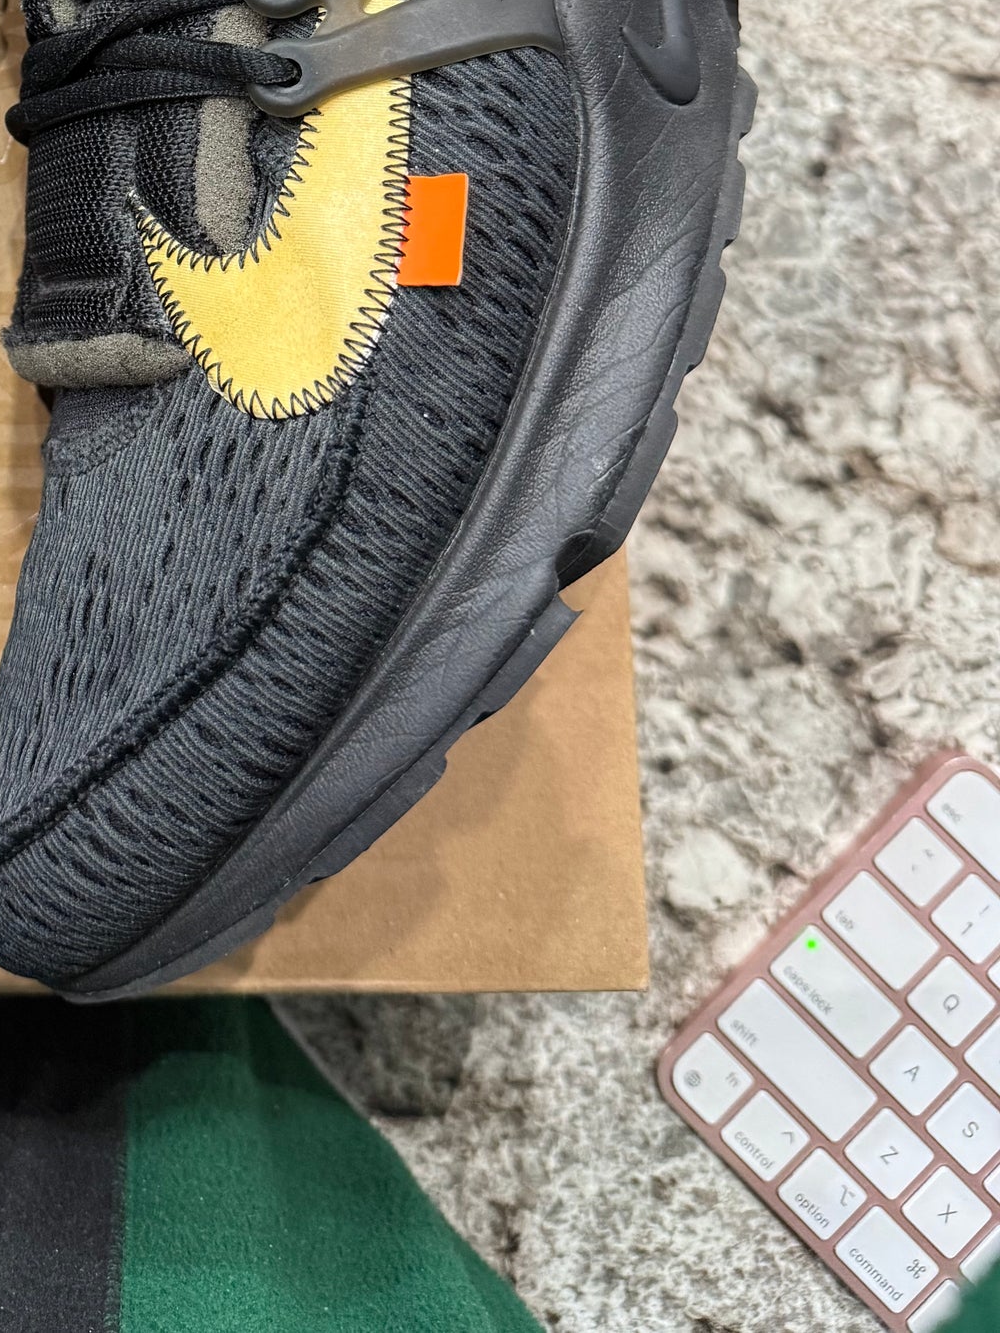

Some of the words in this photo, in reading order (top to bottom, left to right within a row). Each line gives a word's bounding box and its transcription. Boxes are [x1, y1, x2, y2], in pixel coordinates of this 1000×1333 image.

[961, 921, 974, 936] 1
[807, 988, 834, 1016] lock
[943, 994, 960, 1014] Q
[730, 1019, 760, 1048] shift
[724, 1071, 740, 1088] fn
[904, 1065, 921, 1083] A
[962, 1121, 980, 1138] S
[734, 1130, 777, 1170] control
[880, 1145, 900, 1166] Z
[794, 1192, 831, 1229] option
[937, 1203, 958, 1224] X
[848, 1247, 905, 1303] command
